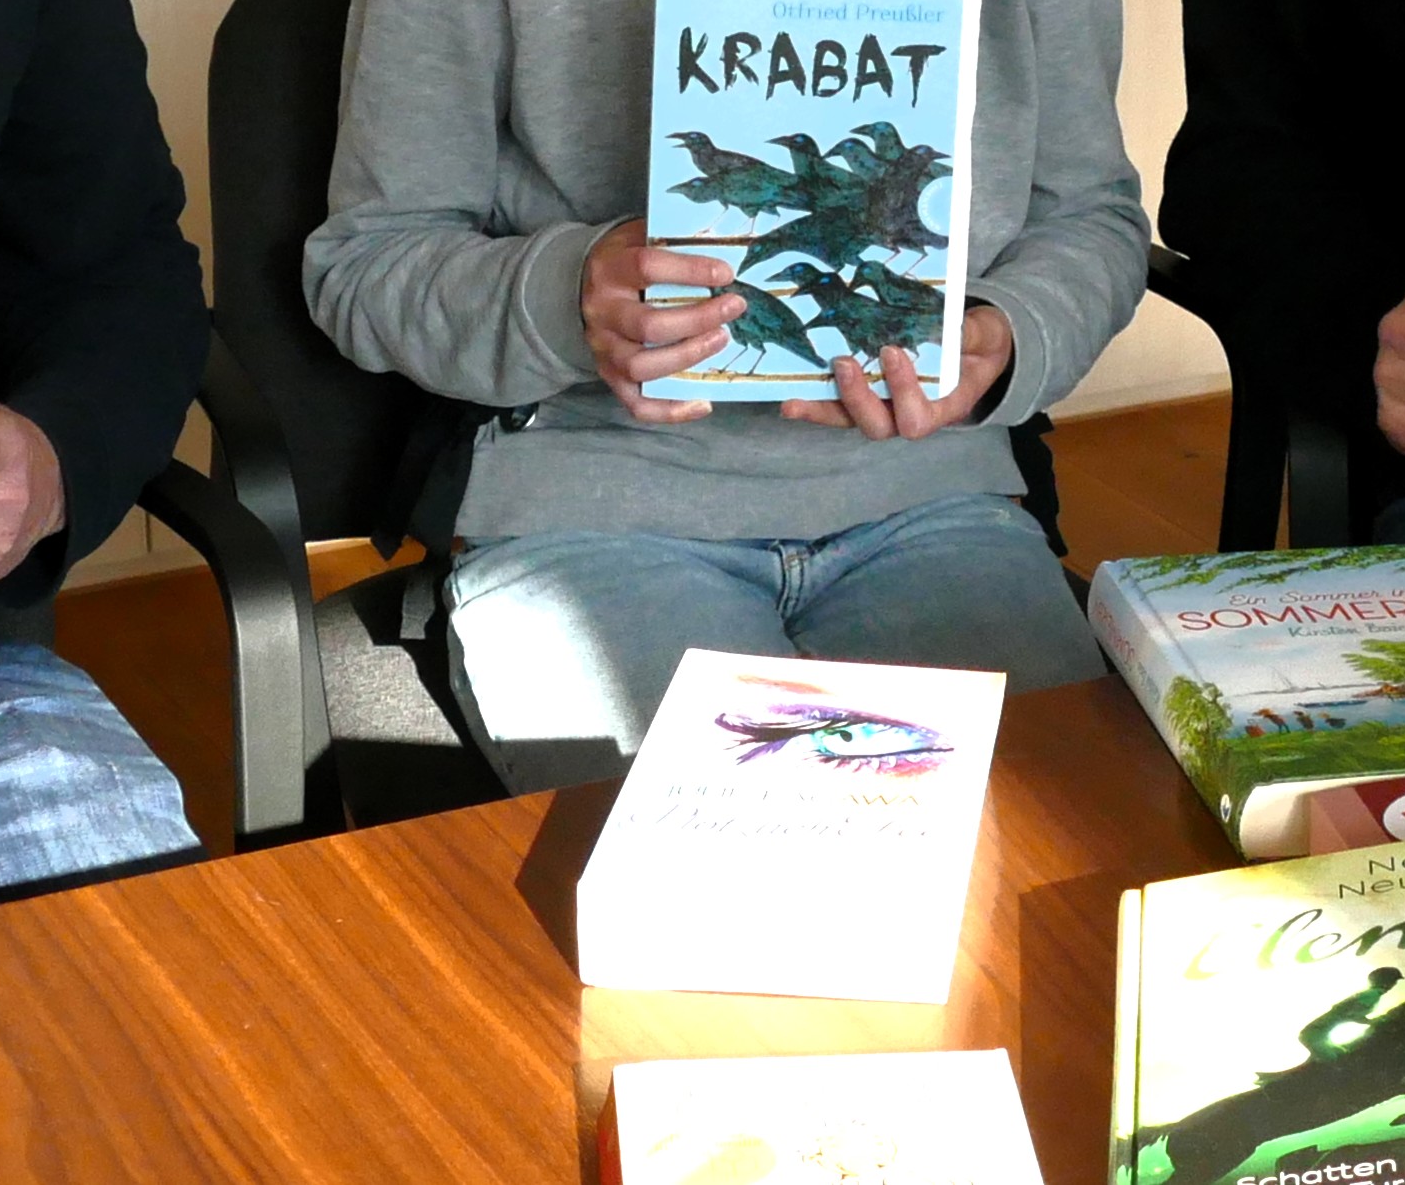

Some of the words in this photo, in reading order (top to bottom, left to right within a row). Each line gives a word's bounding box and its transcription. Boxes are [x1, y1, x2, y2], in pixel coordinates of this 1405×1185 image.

[772, 1, 847, 21] Otfried
[856, 3, 945, 23] Preußler
[677, 26, 946, 108] KRABAT
[1229, 594, 1266, 607] Ein
[1279, 590, 1379, 604] Sommer
[1288, 626, 1360, 638] Kirsten
